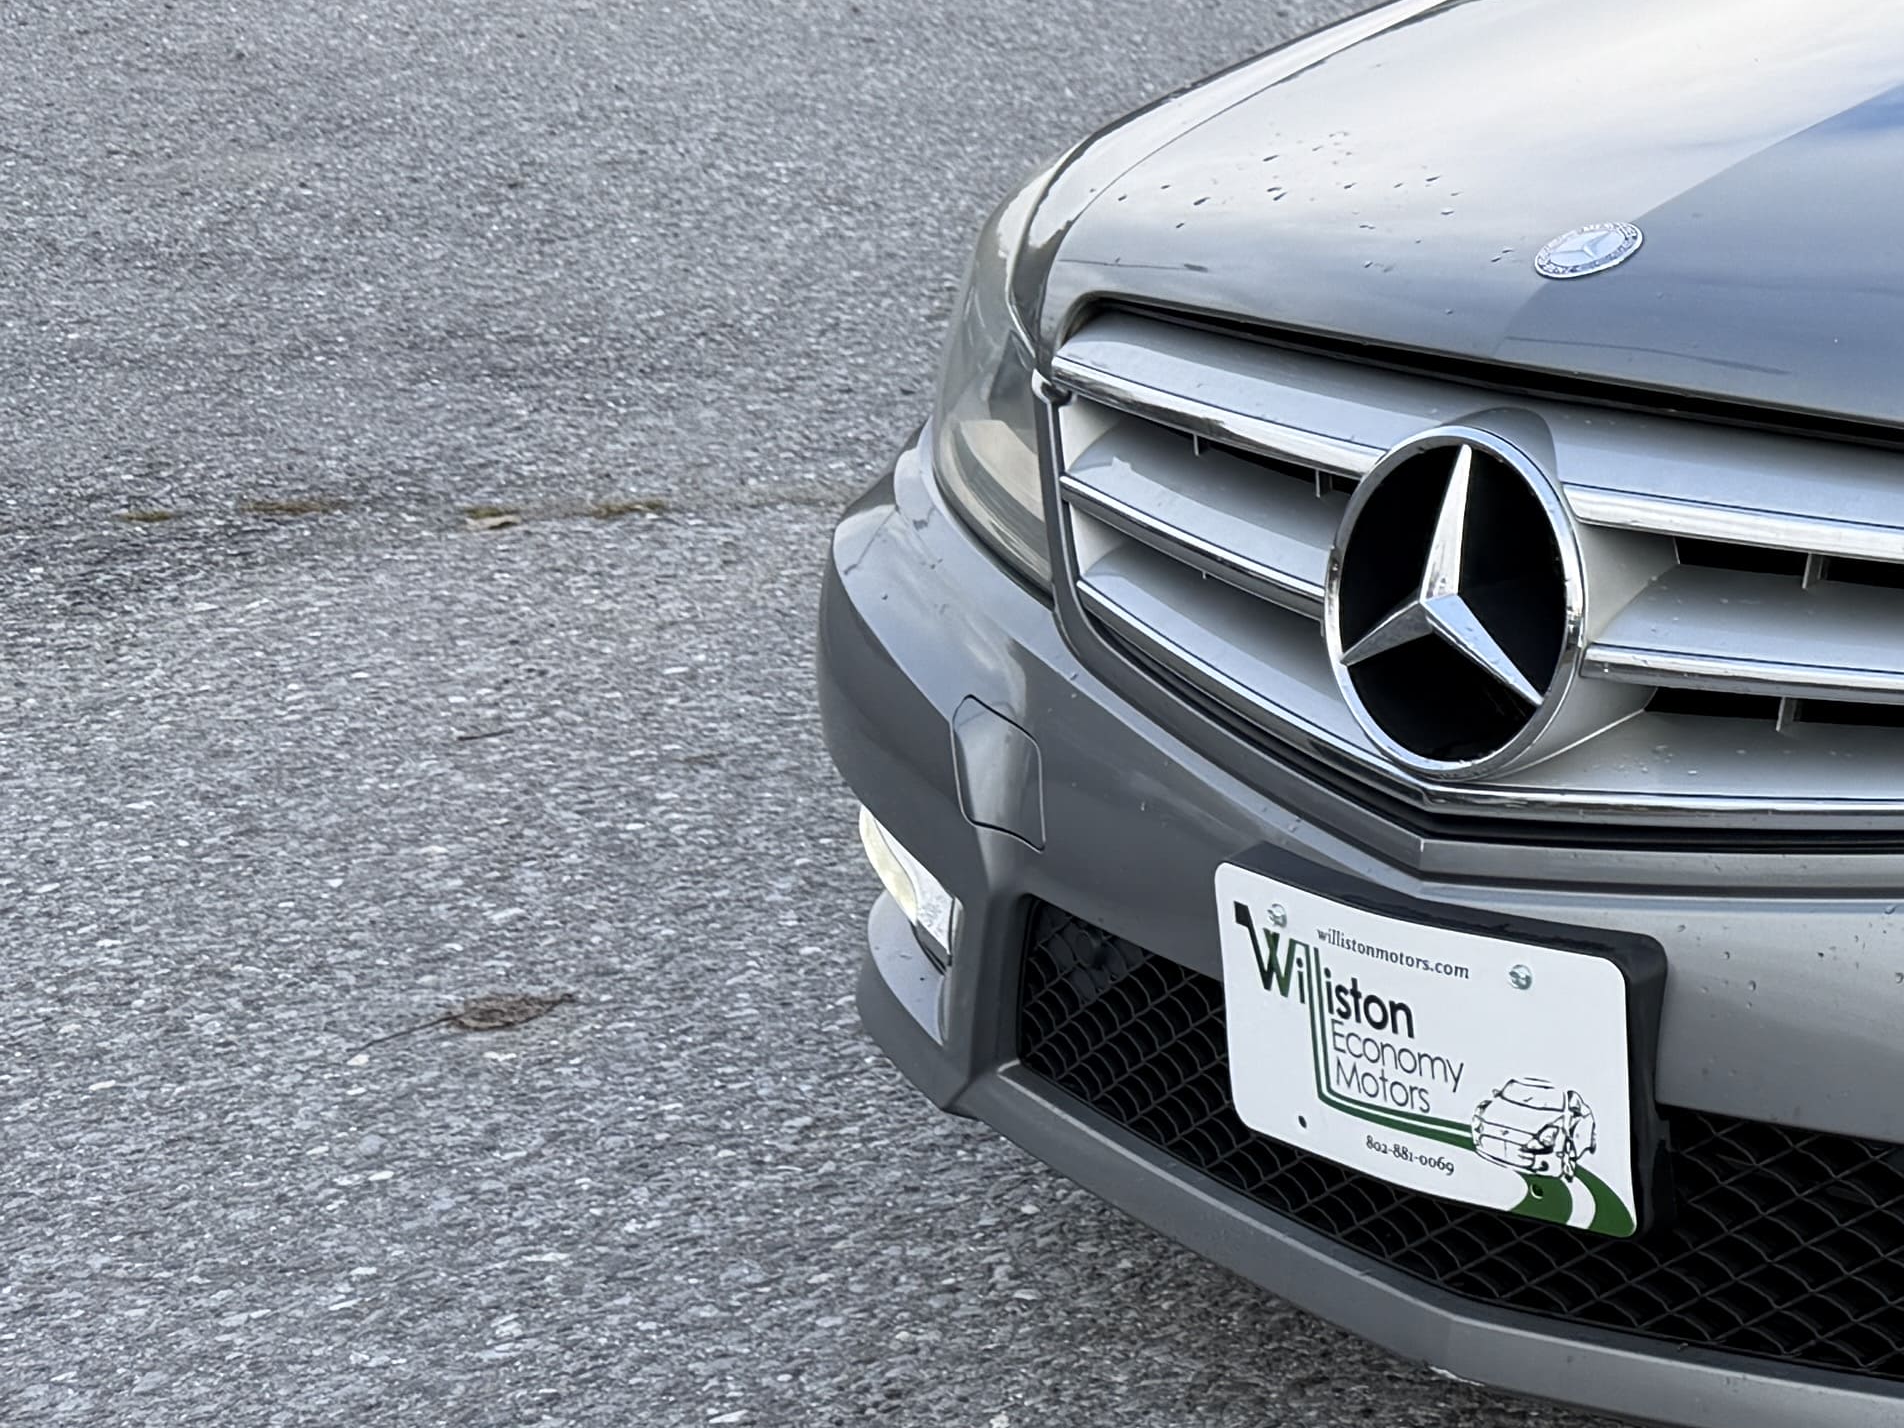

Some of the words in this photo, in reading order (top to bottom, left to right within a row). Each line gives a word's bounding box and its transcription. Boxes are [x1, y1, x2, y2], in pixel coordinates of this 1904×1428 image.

[1233, 900, 1415, 1040] Williston
[1316, 927, 1470, 980] willistonmotors.com
[1331, 1018, 1464, 1093] Economy
[1336, 1056, 1431, 1113] Motors
[1365, 1134, 1455, 1176] 802-881-0069
